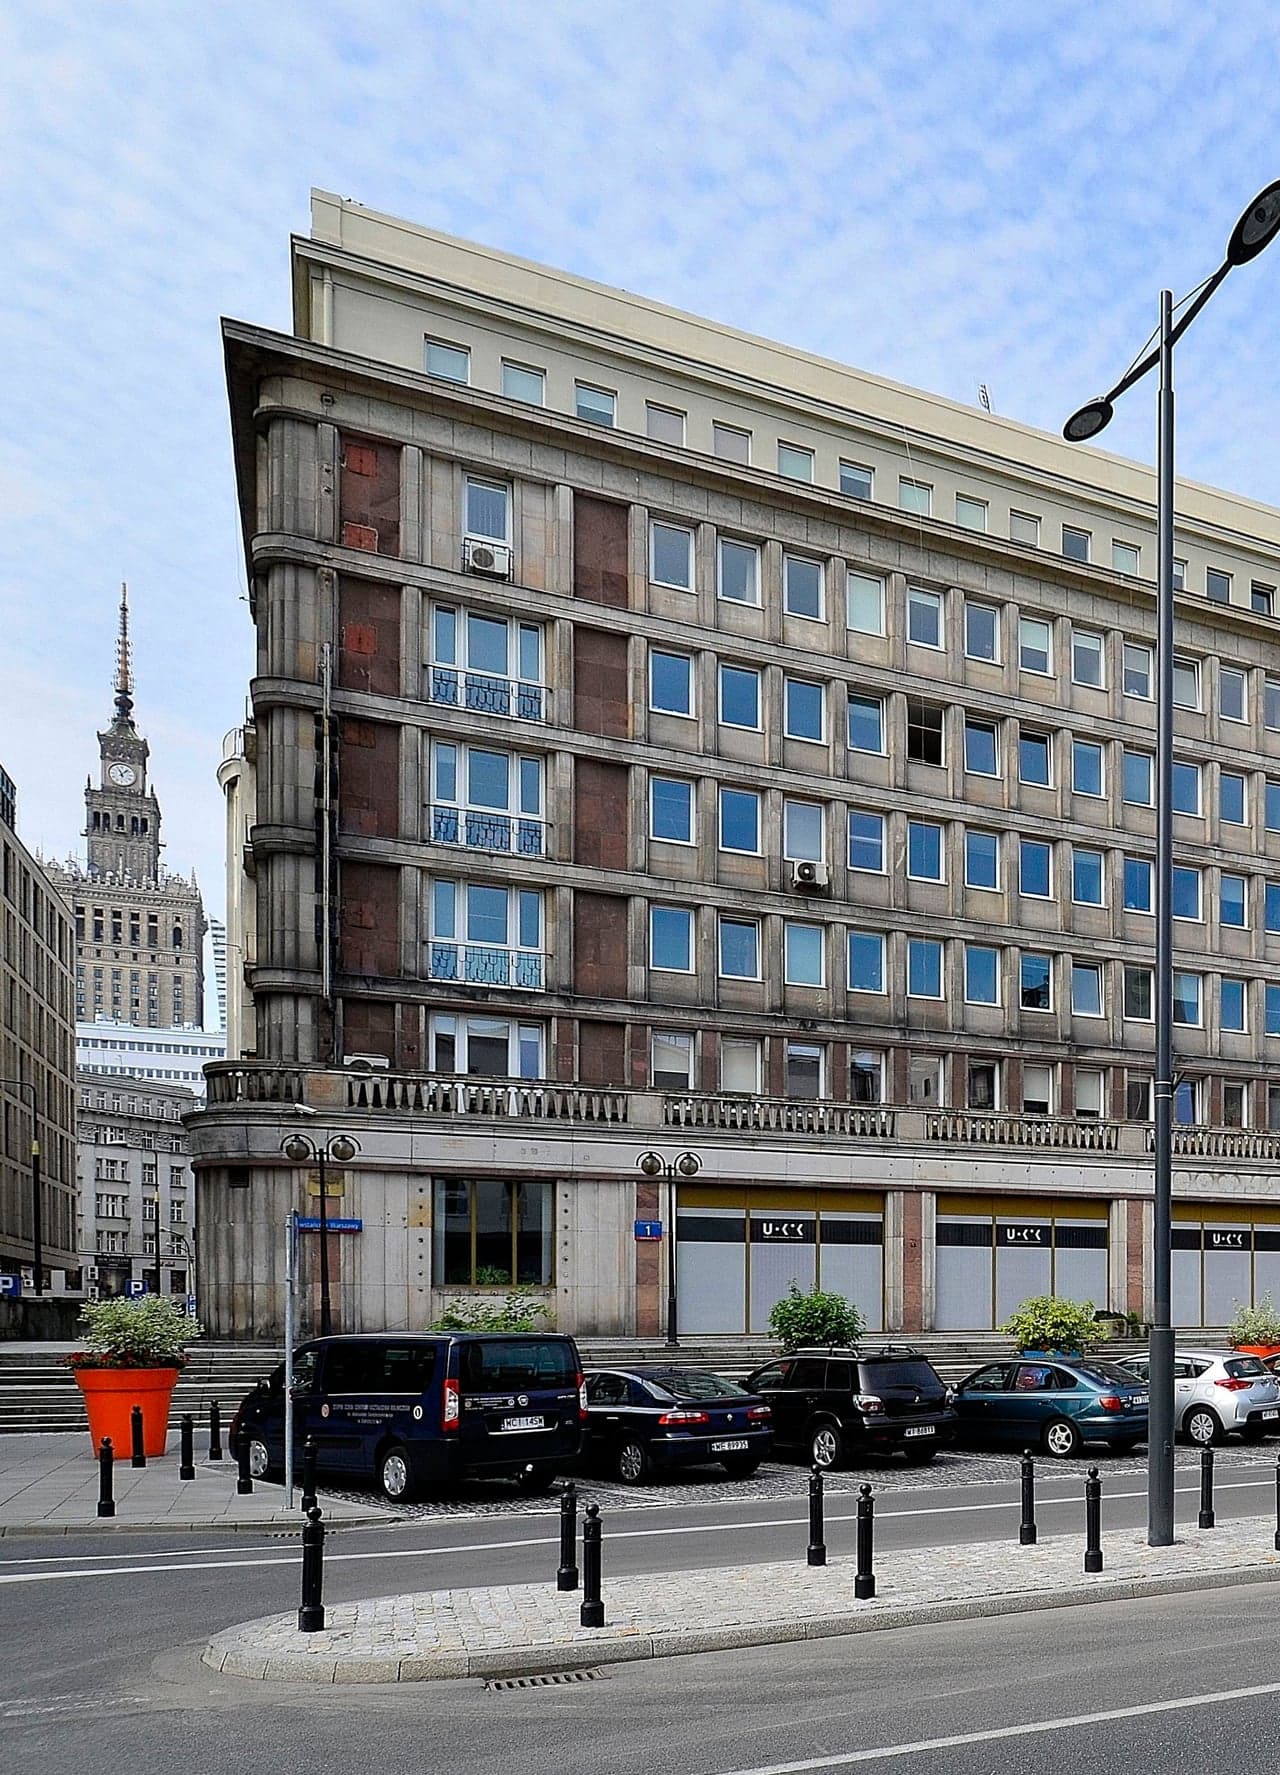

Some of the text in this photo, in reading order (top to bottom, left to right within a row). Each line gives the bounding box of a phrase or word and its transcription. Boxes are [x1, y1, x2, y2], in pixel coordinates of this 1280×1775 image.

[645, 1226, 651, 1236] 1
[0, 1277, 13, 1293] P
[131, 1282, 143, 1295] P
